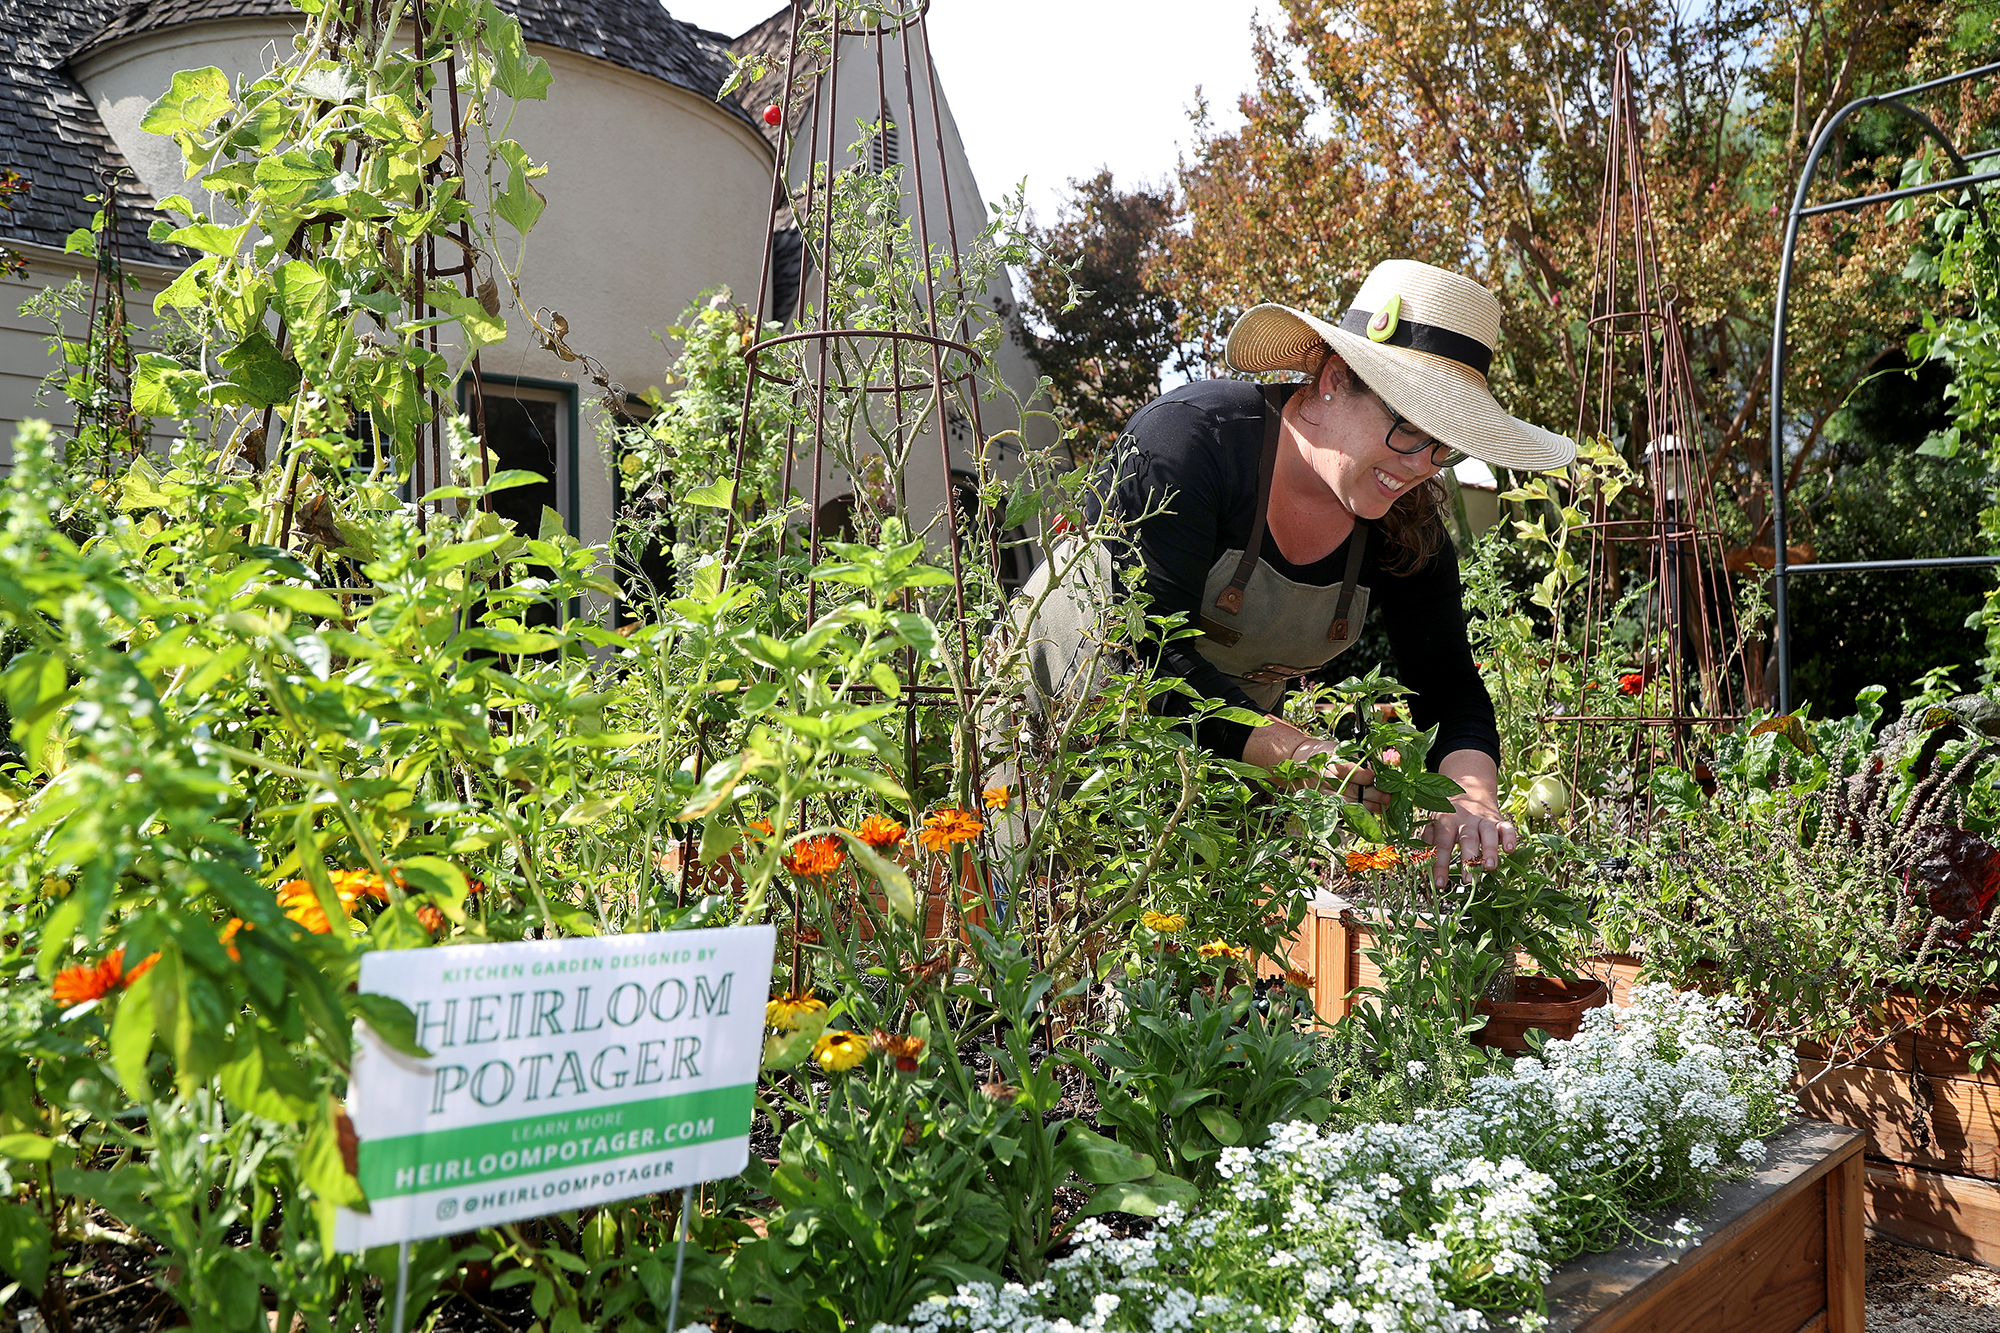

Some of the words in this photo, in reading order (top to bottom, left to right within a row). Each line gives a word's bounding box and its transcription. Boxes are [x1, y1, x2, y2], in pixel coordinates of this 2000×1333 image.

[442, 966, 524, 983] KITCHEN
[532, 958, 602, 976] GARDEN
[611, 950, 691, 969] DESIGNED
[697, 948, 717, 962] BY
[415, 971, 734, 1048] HEIRLOOM
[429, 1035, 703, 1115] POTAGER
[395, 1117, 716, 1190] HEIRLOOMPOTAGER.COM
[511, 1121, 570, 1143] LEARN
[575, 1110, 625, 1132] MORE
[464, 1161, 675, 1213] @HEIRLOOMPOTAGER
